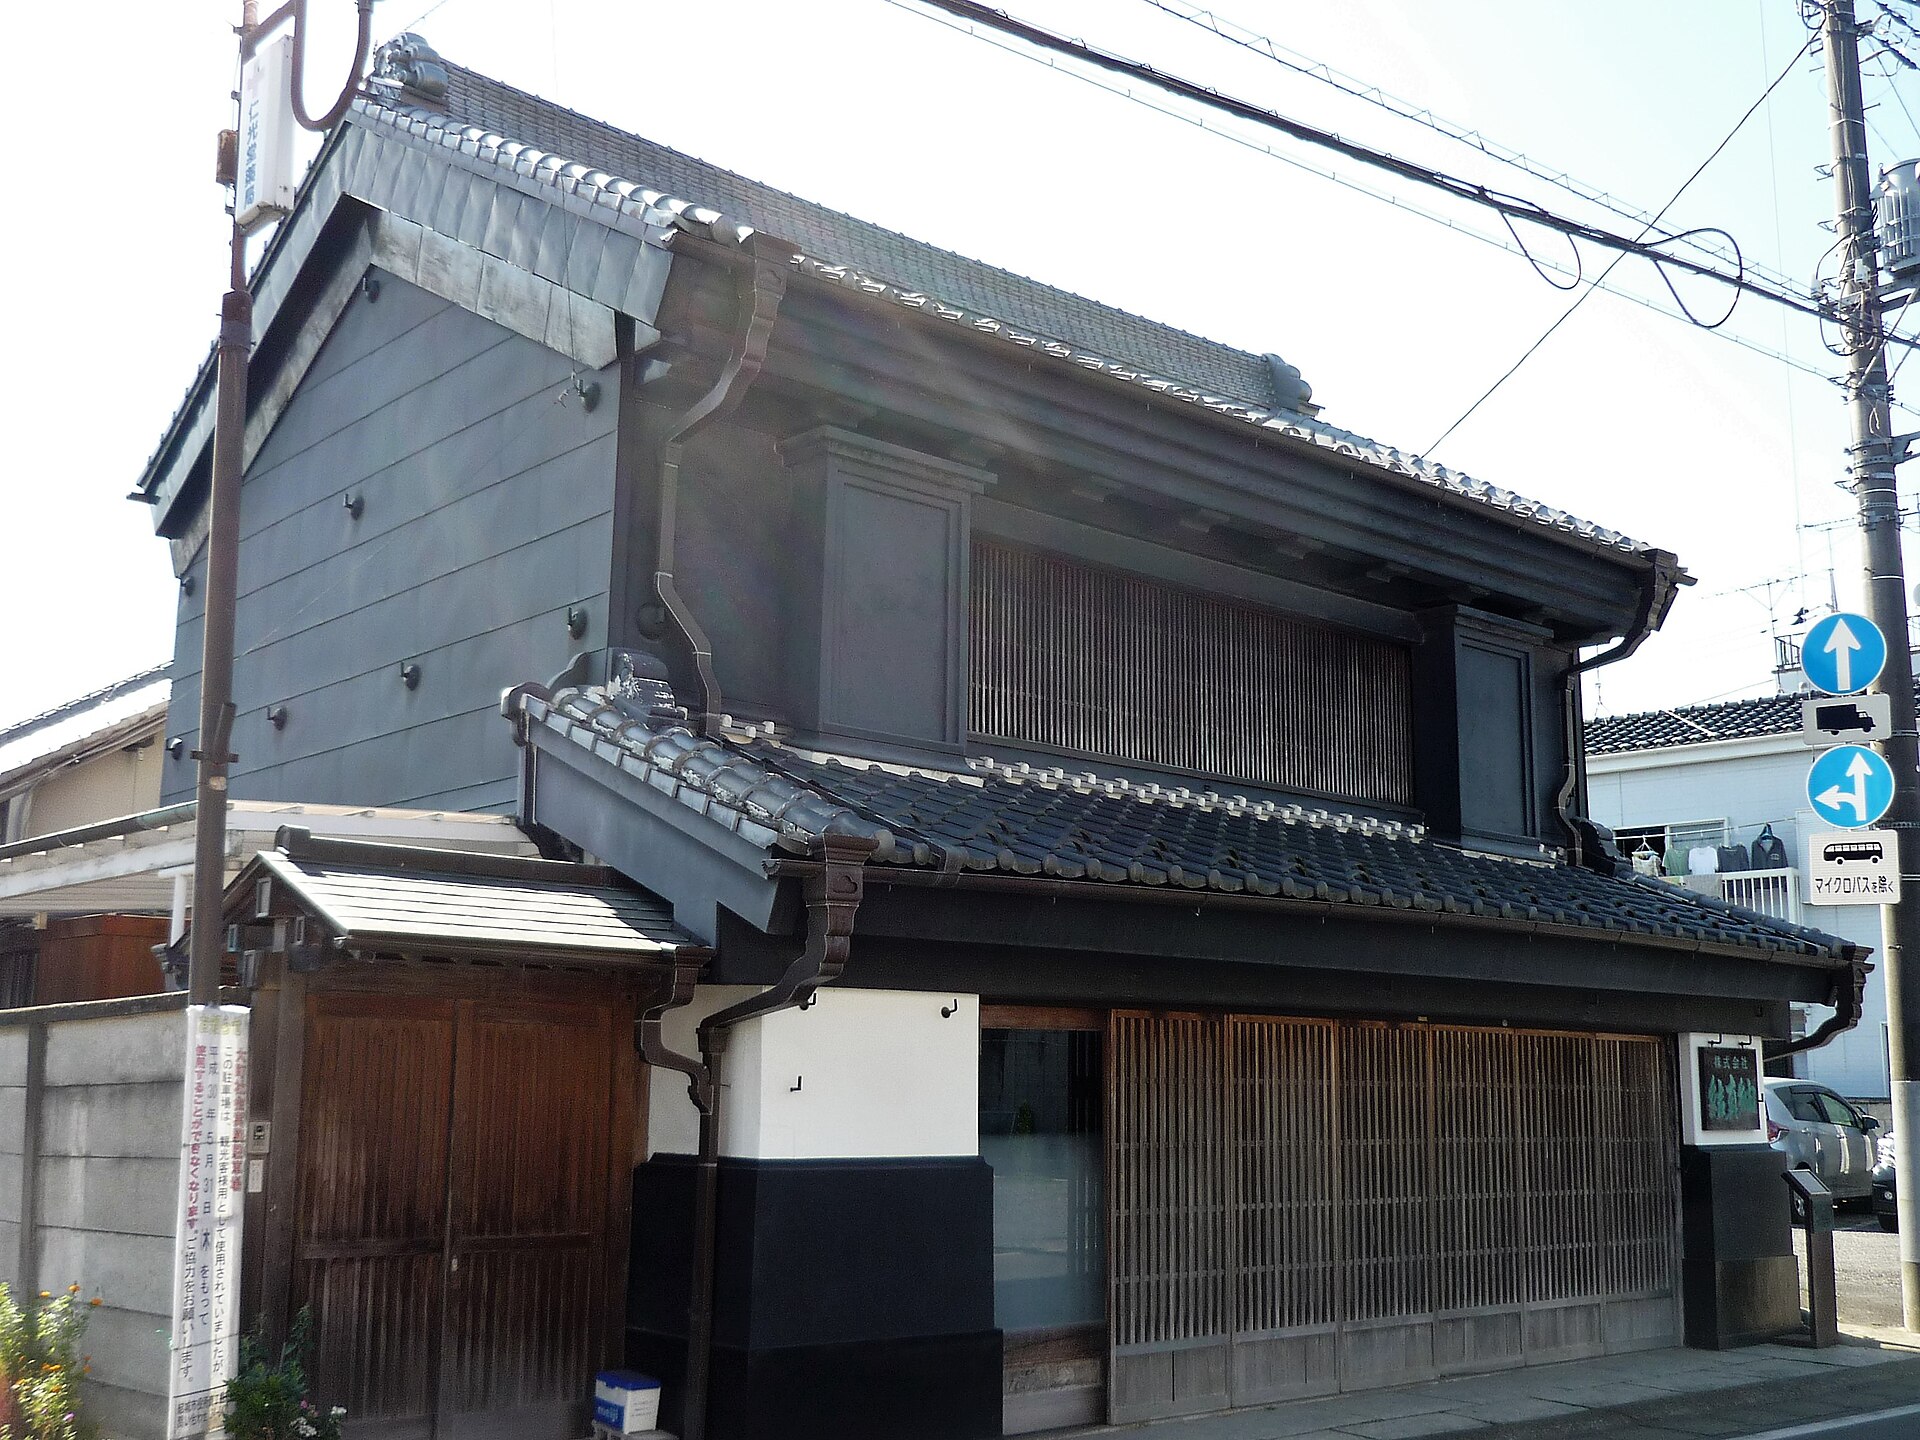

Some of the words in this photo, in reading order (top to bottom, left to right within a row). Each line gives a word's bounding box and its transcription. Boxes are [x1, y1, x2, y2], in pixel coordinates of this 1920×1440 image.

[1814, 875, 1894, 894] マイクロバスを除く
[1714, 1055, 1749, 1070] 株式会社
